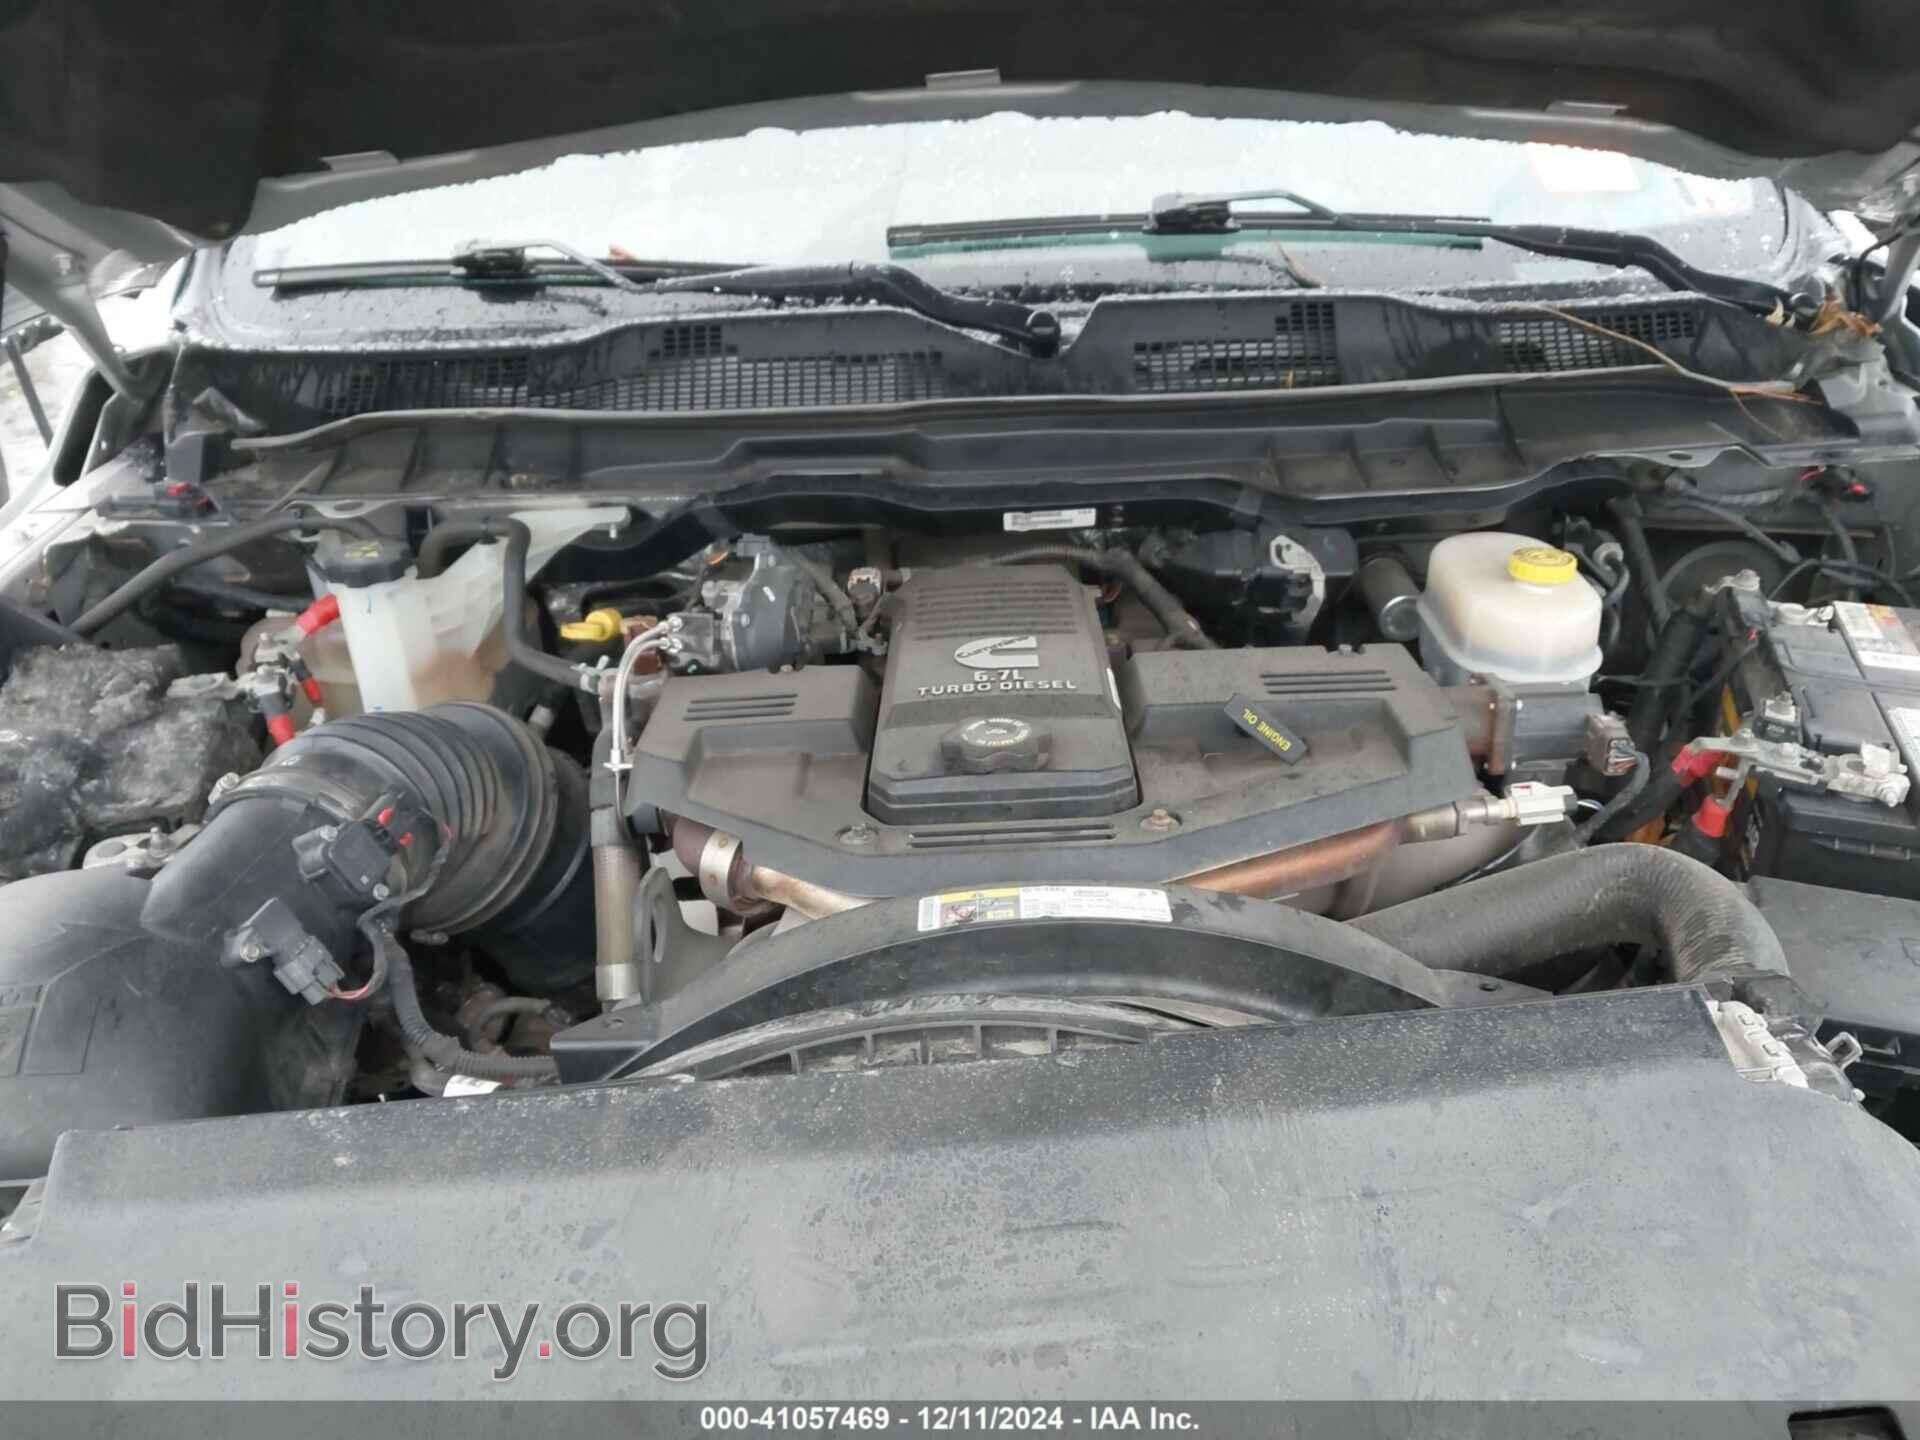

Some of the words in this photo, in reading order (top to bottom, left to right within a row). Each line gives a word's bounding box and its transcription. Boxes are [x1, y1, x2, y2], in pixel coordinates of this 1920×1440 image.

[973, 669, 1025, 683] 6.7L
[917, 682, 992, 697] TURBO
[999, 680, 1078, 691] DIESEL
[1242, 707, 1258, 725] OIL
[1256, 721, 1292, 752] ENGINE
